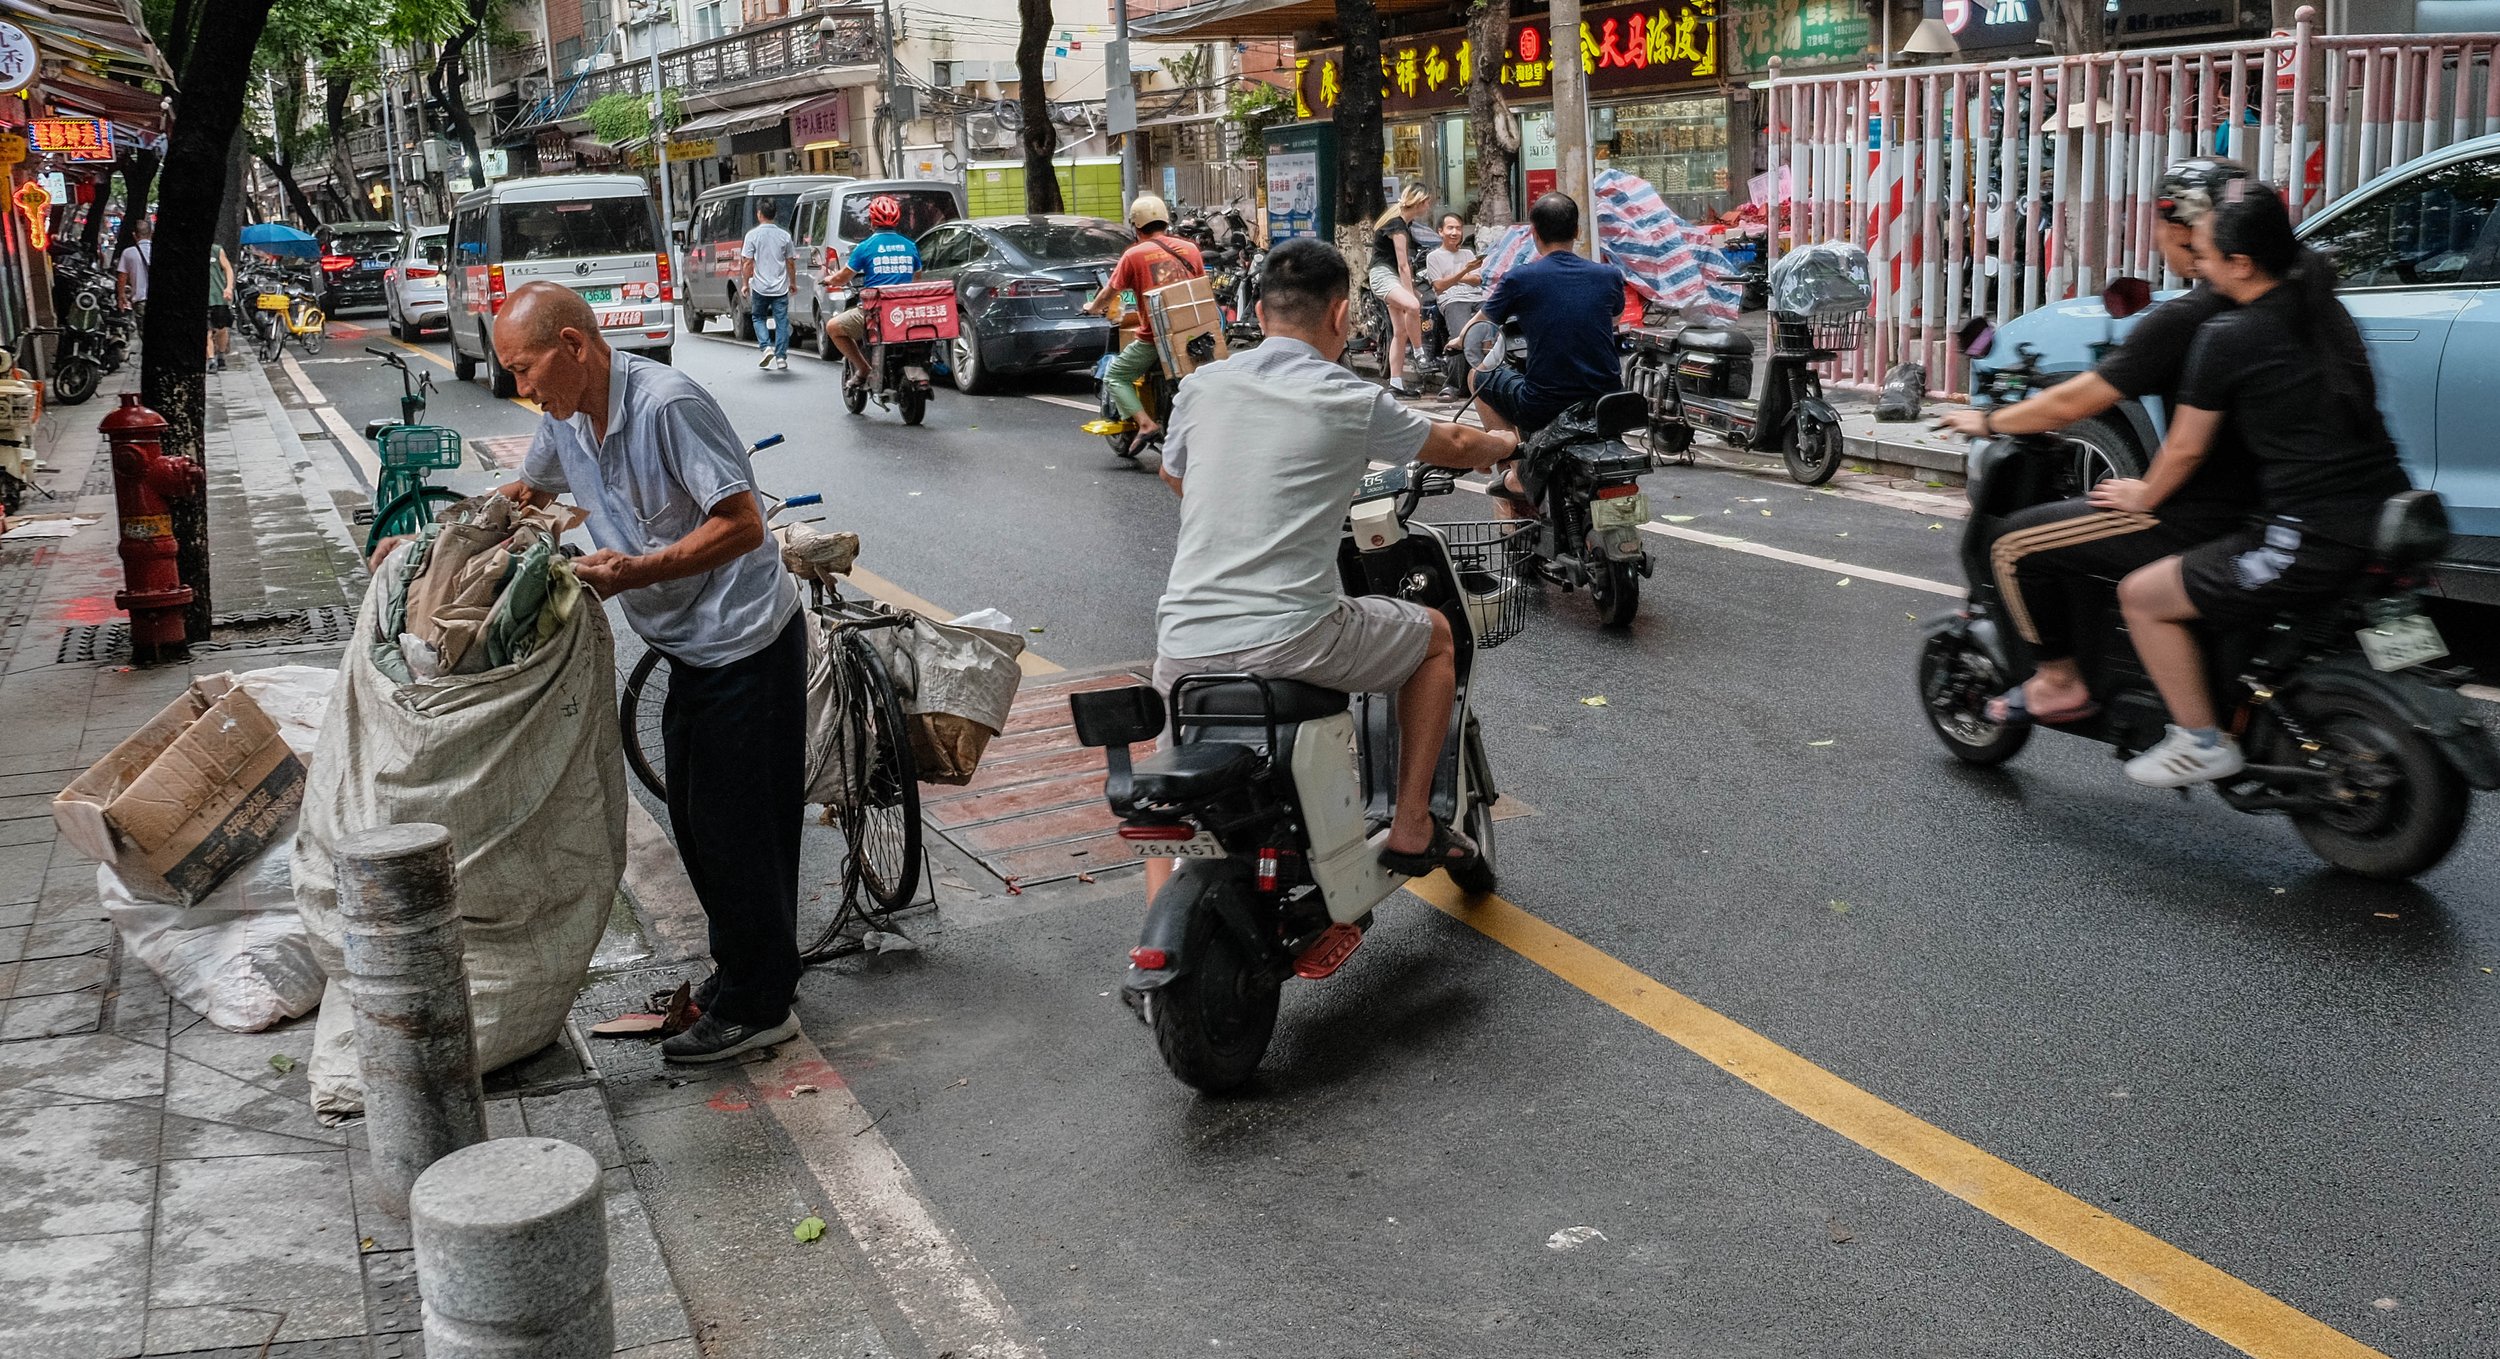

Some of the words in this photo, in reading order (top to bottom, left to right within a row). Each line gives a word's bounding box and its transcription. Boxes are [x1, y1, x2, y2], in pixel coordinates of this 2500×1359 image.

[1546, 8, 1701, 74] 会天马陈皮
[904, 304, 947, 319] 永辉生活
